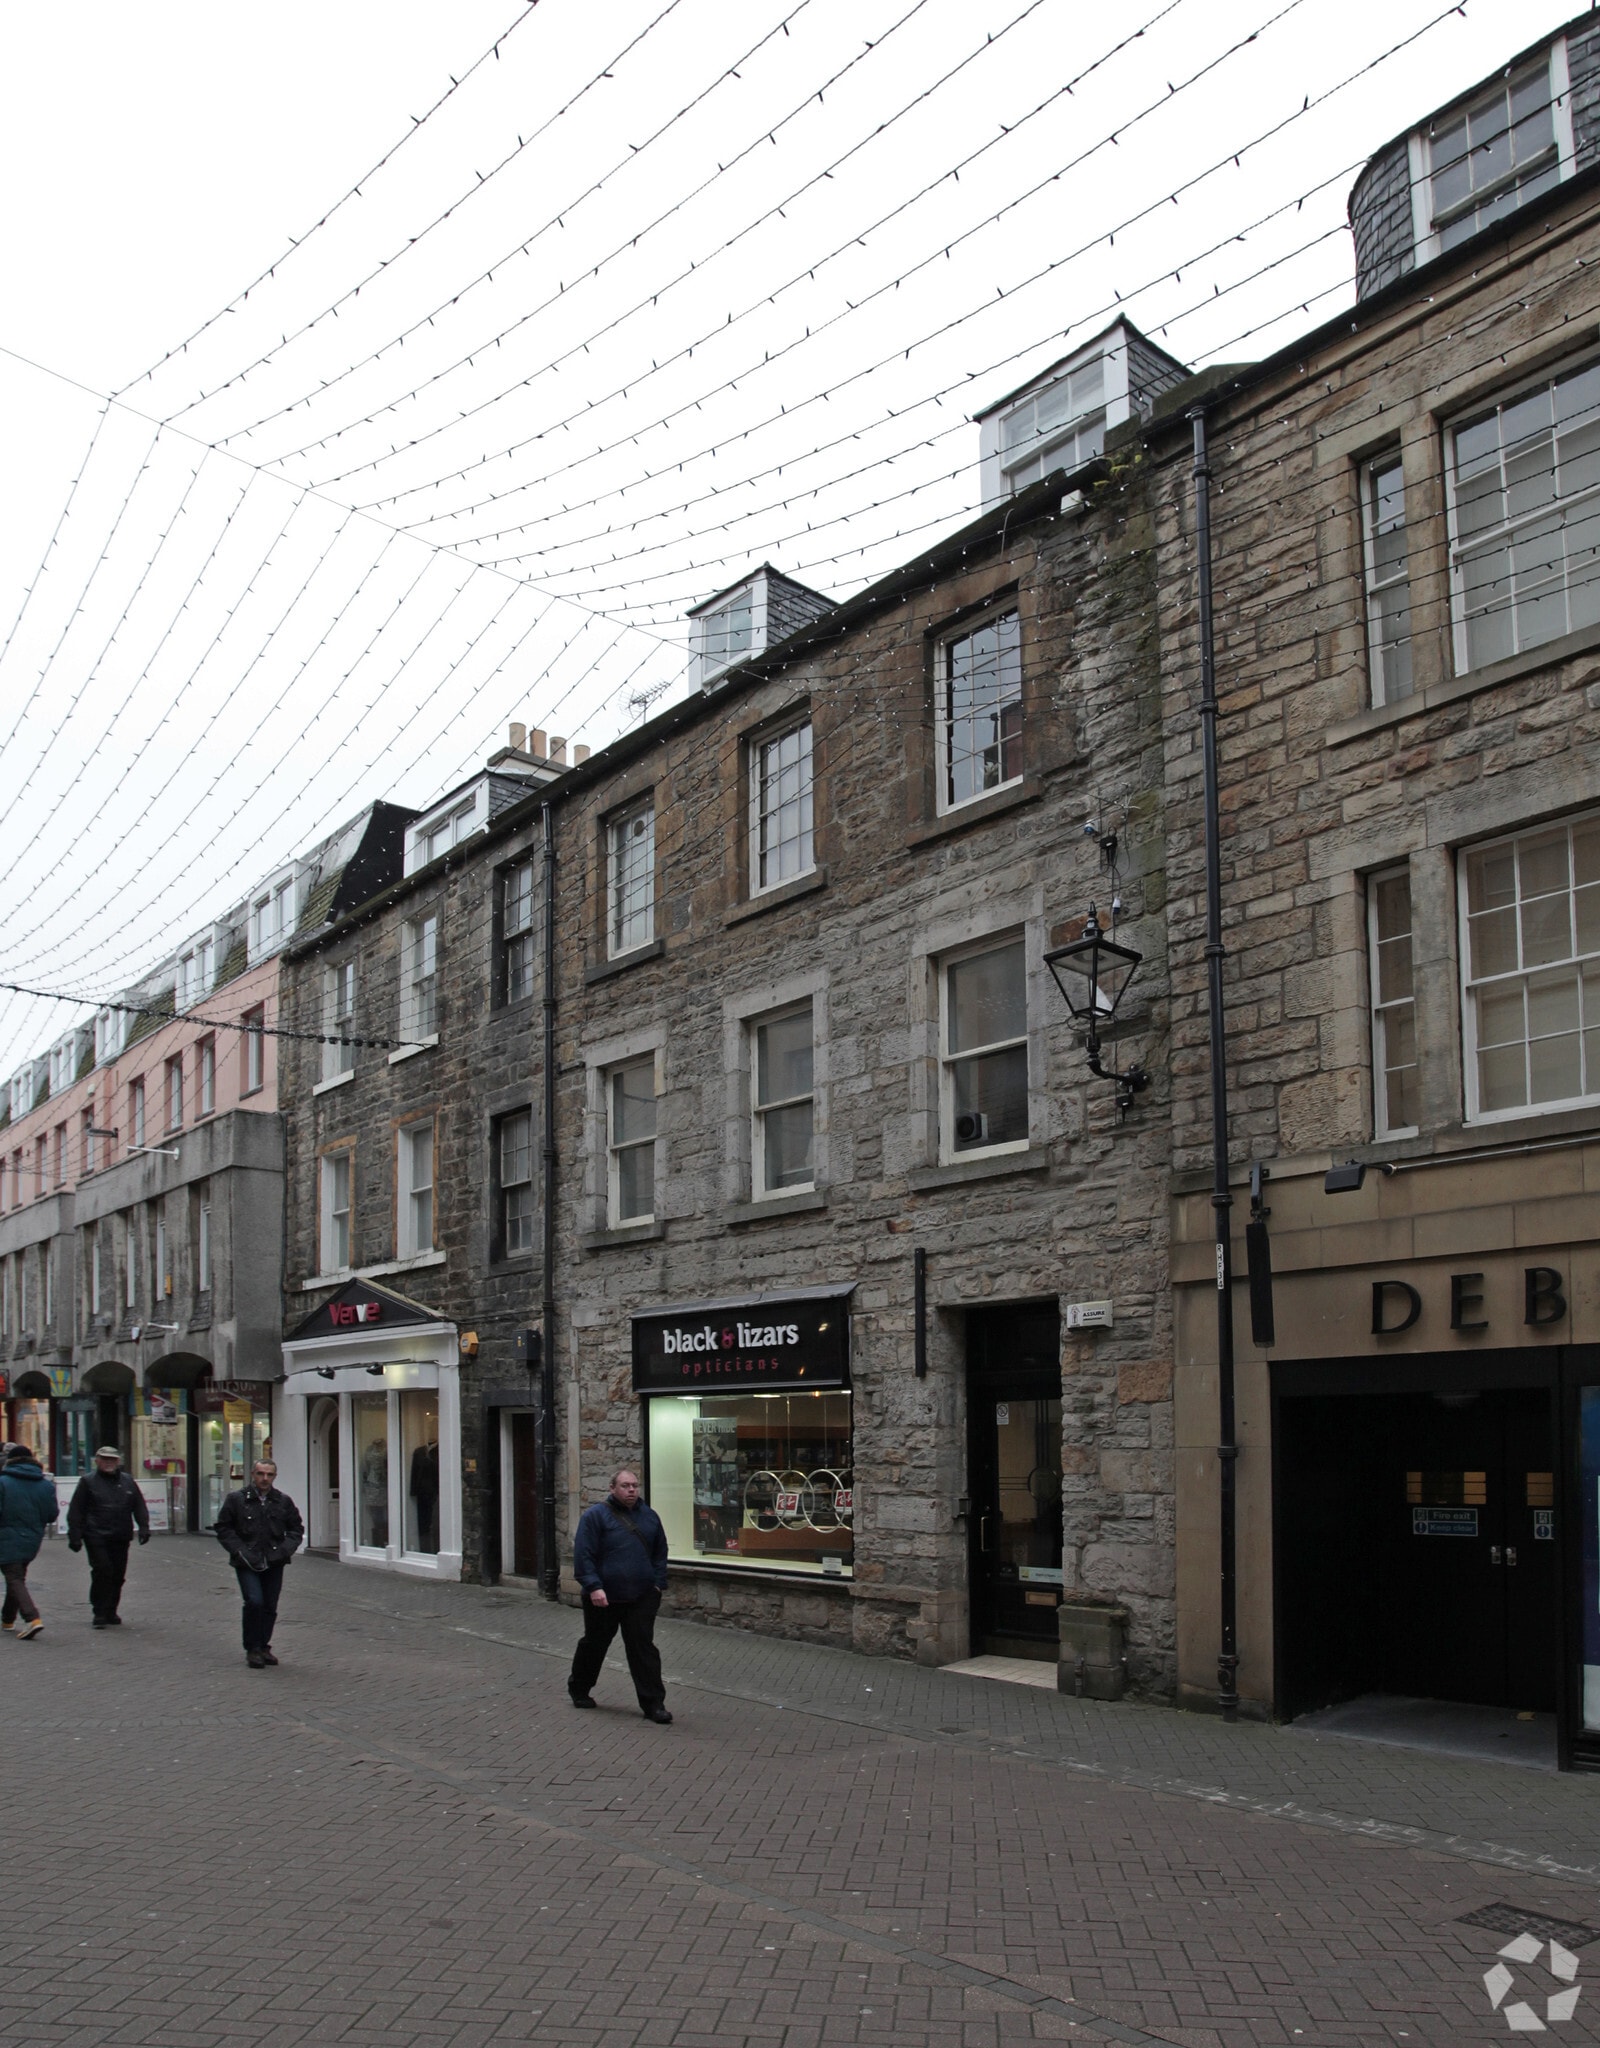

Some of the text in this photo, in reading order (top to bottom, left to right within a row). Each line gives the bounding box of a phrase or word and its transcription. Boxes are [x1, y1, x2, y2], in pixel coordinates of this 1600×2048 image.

[1371, 1267, 1567, 1335] DEB
[329, 1302, 381, 1326] Verve
[663, 1322, 800, 1354] black & lizars
[682, 1357, 779, 1376] opticians
[693, 1421, 717, 1434] NEVER
[1433, 1511, 1471, 1520] Fire exit
[1429, 1524, 1452, 1533] Keep
